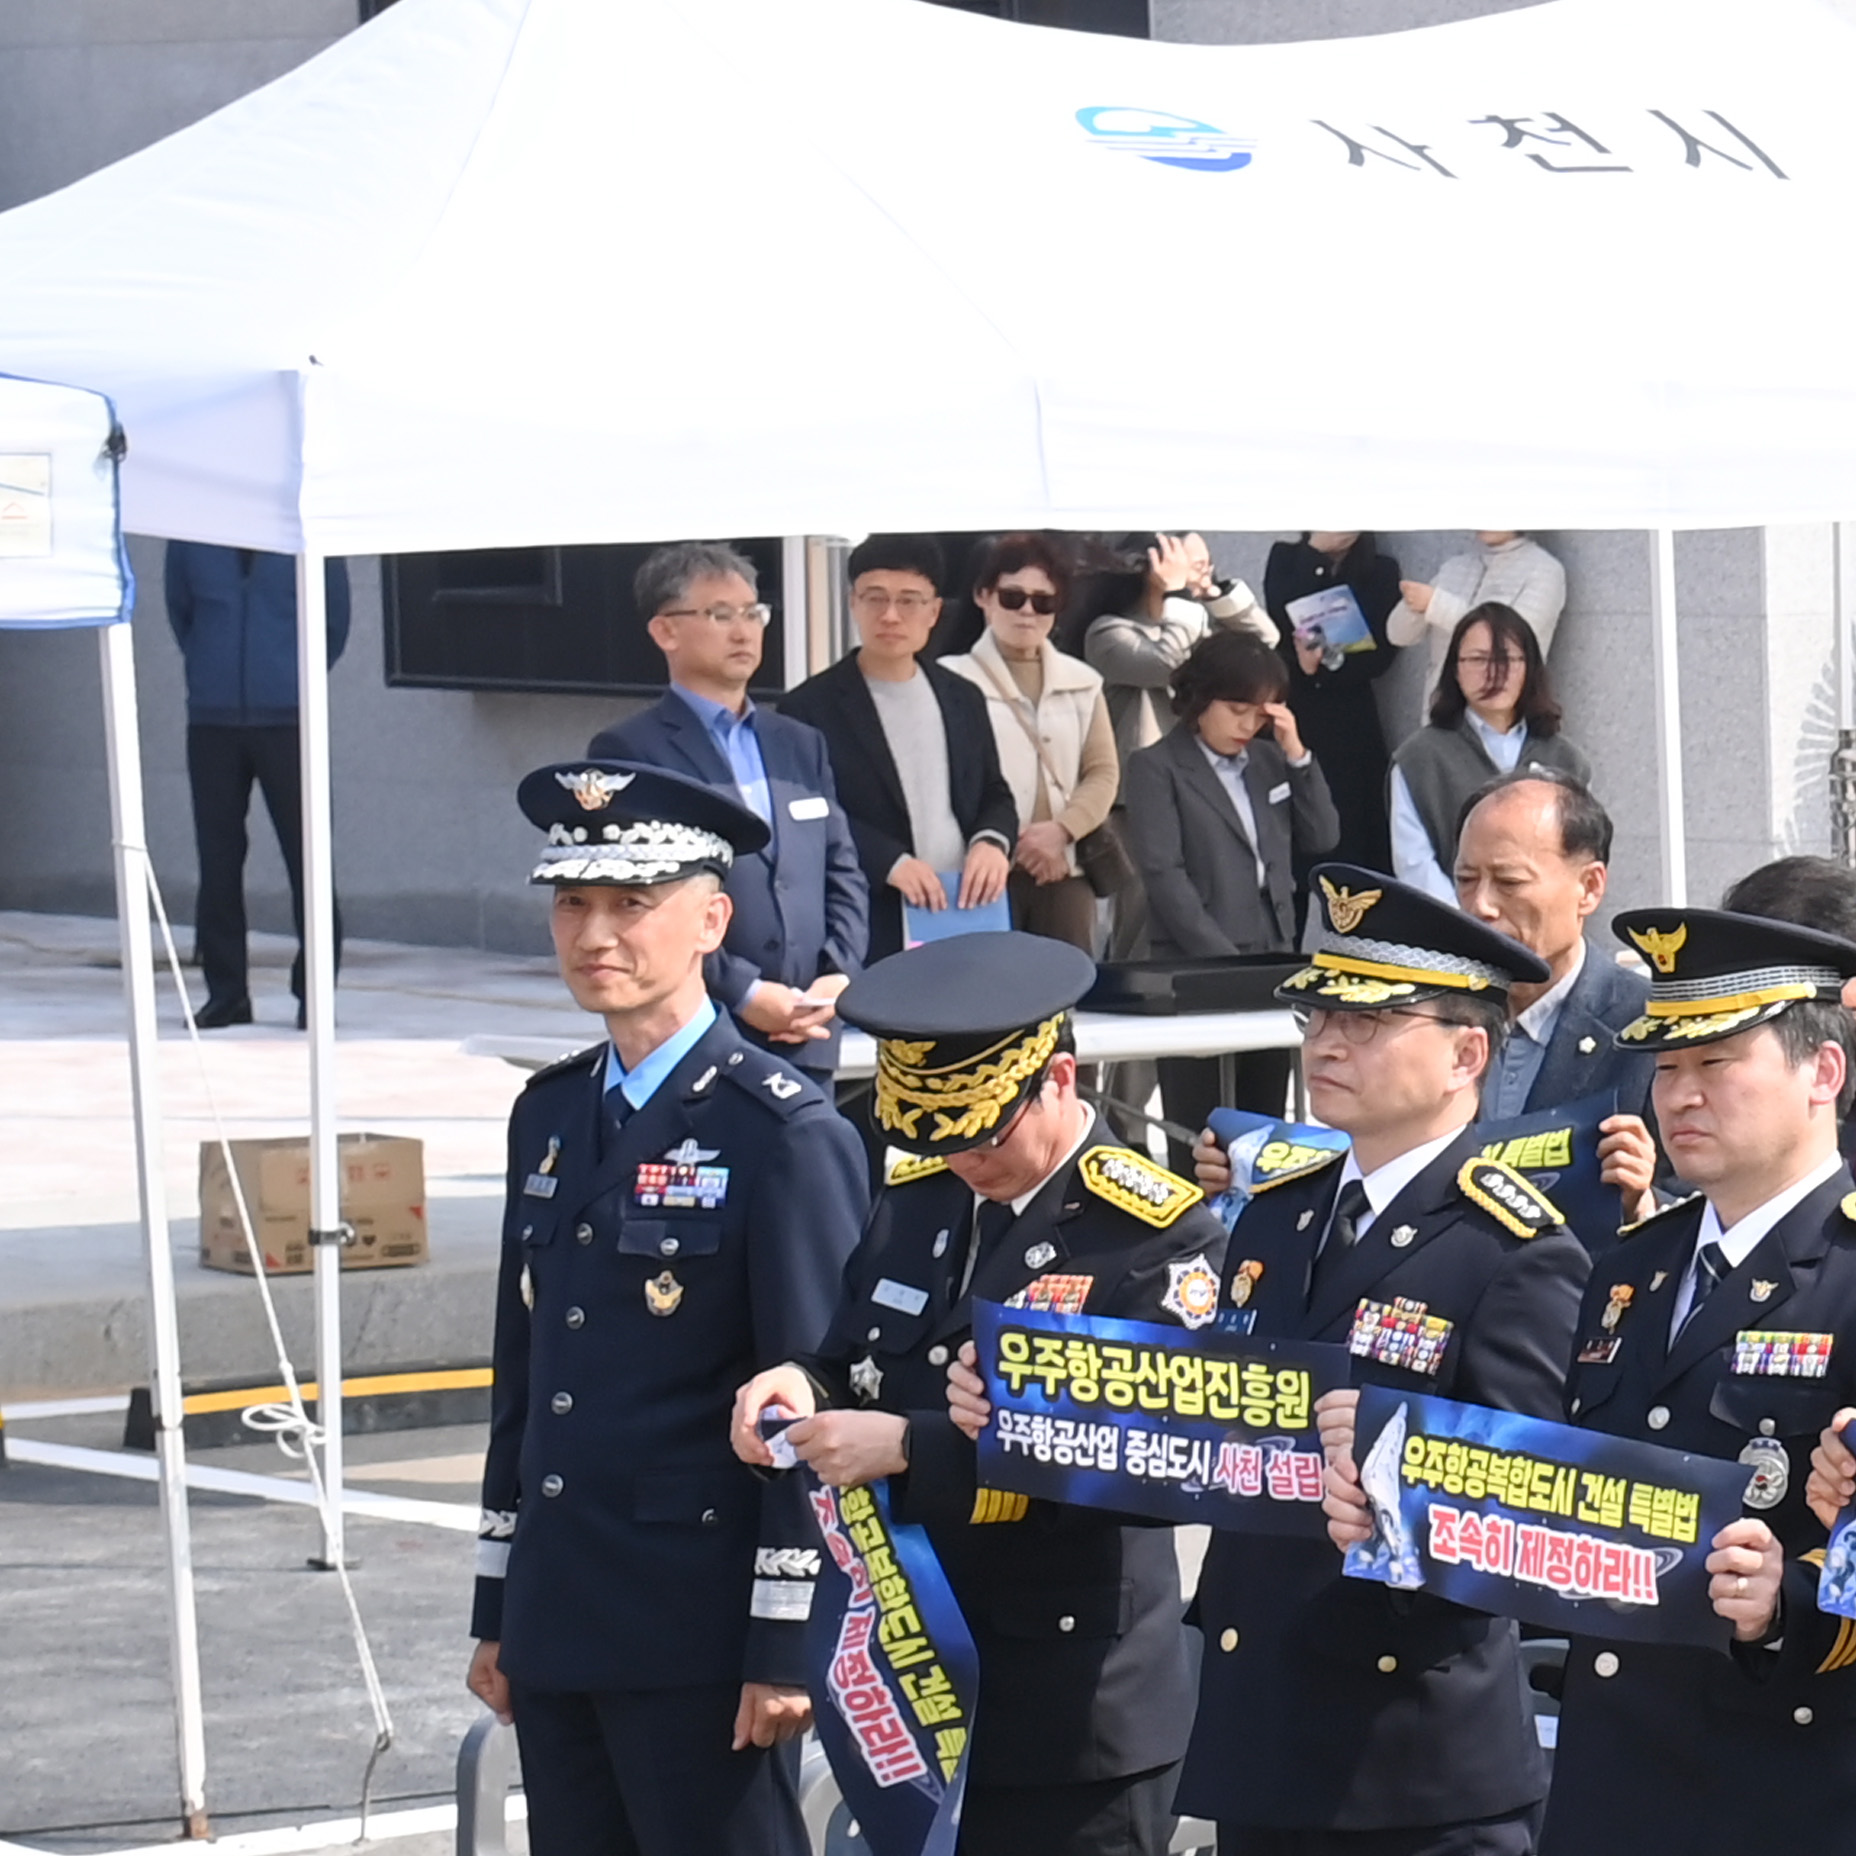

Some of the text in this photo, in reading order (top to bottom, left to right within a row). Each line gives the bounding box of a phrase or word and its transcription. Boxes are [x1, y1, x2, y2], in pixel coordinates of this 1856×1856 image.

[1309, 107, 1791, 180] 사천시
[997, 1331, 1311, 1430] 우주항공산업진흥원
[996, 1409, 1120, 1473] 우주항공산업
[1125, 1428, 1211, 1485] 중심도시
[1213, 1442, 1263, 1494] 사천
[1401, 1435, 1701, 1544] 우주항공복합도시 건설 특별법
[1426, 1505, 1662, 1606] 조속히 제정하라!!
[827, 1604, 928, 1788] 제정하라!!
[898, 1665, 963, 1728] 건설
